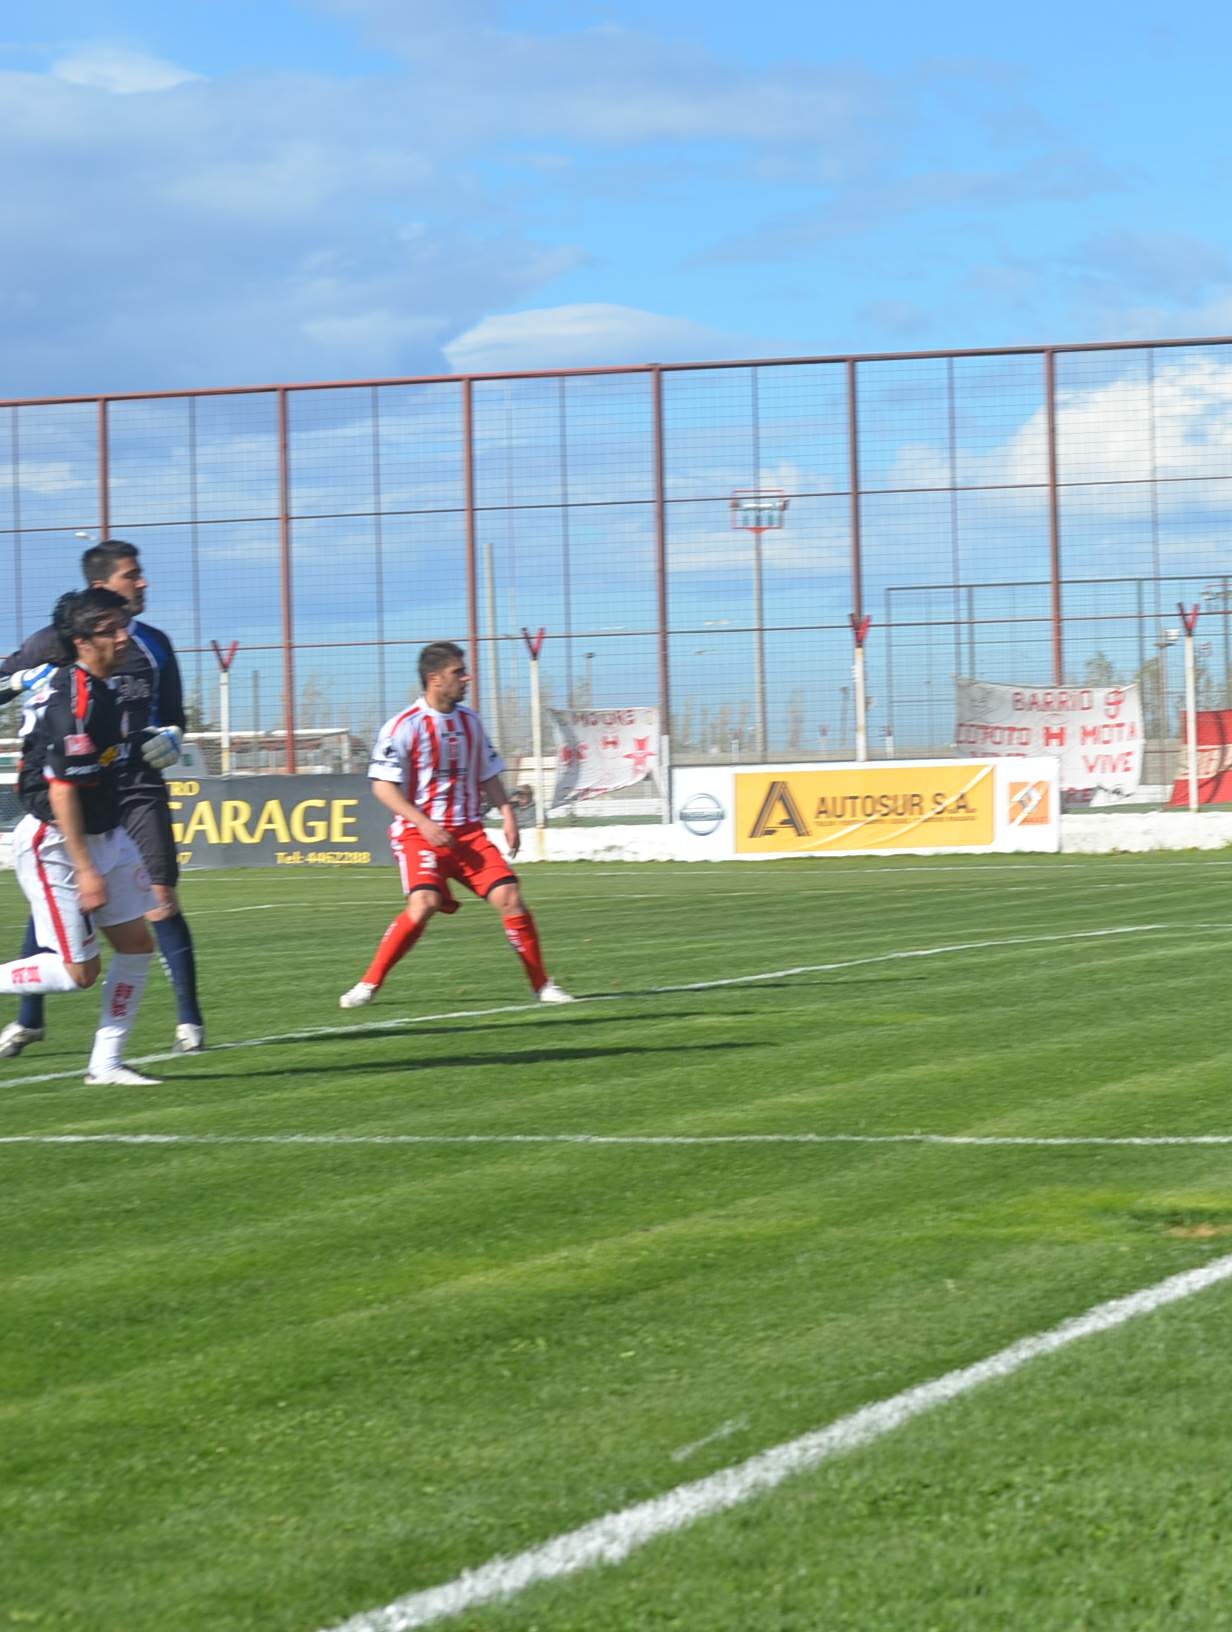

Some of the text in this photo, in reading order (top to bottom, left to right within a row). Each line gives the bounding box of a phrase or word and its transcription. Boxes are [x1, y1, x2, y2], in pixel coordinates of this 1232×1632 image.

[1012, 690, 1094, 711] BARRIO
[1042, 726, 1067, 747] H
[814, 794, 925, 818] AUTOSUR
